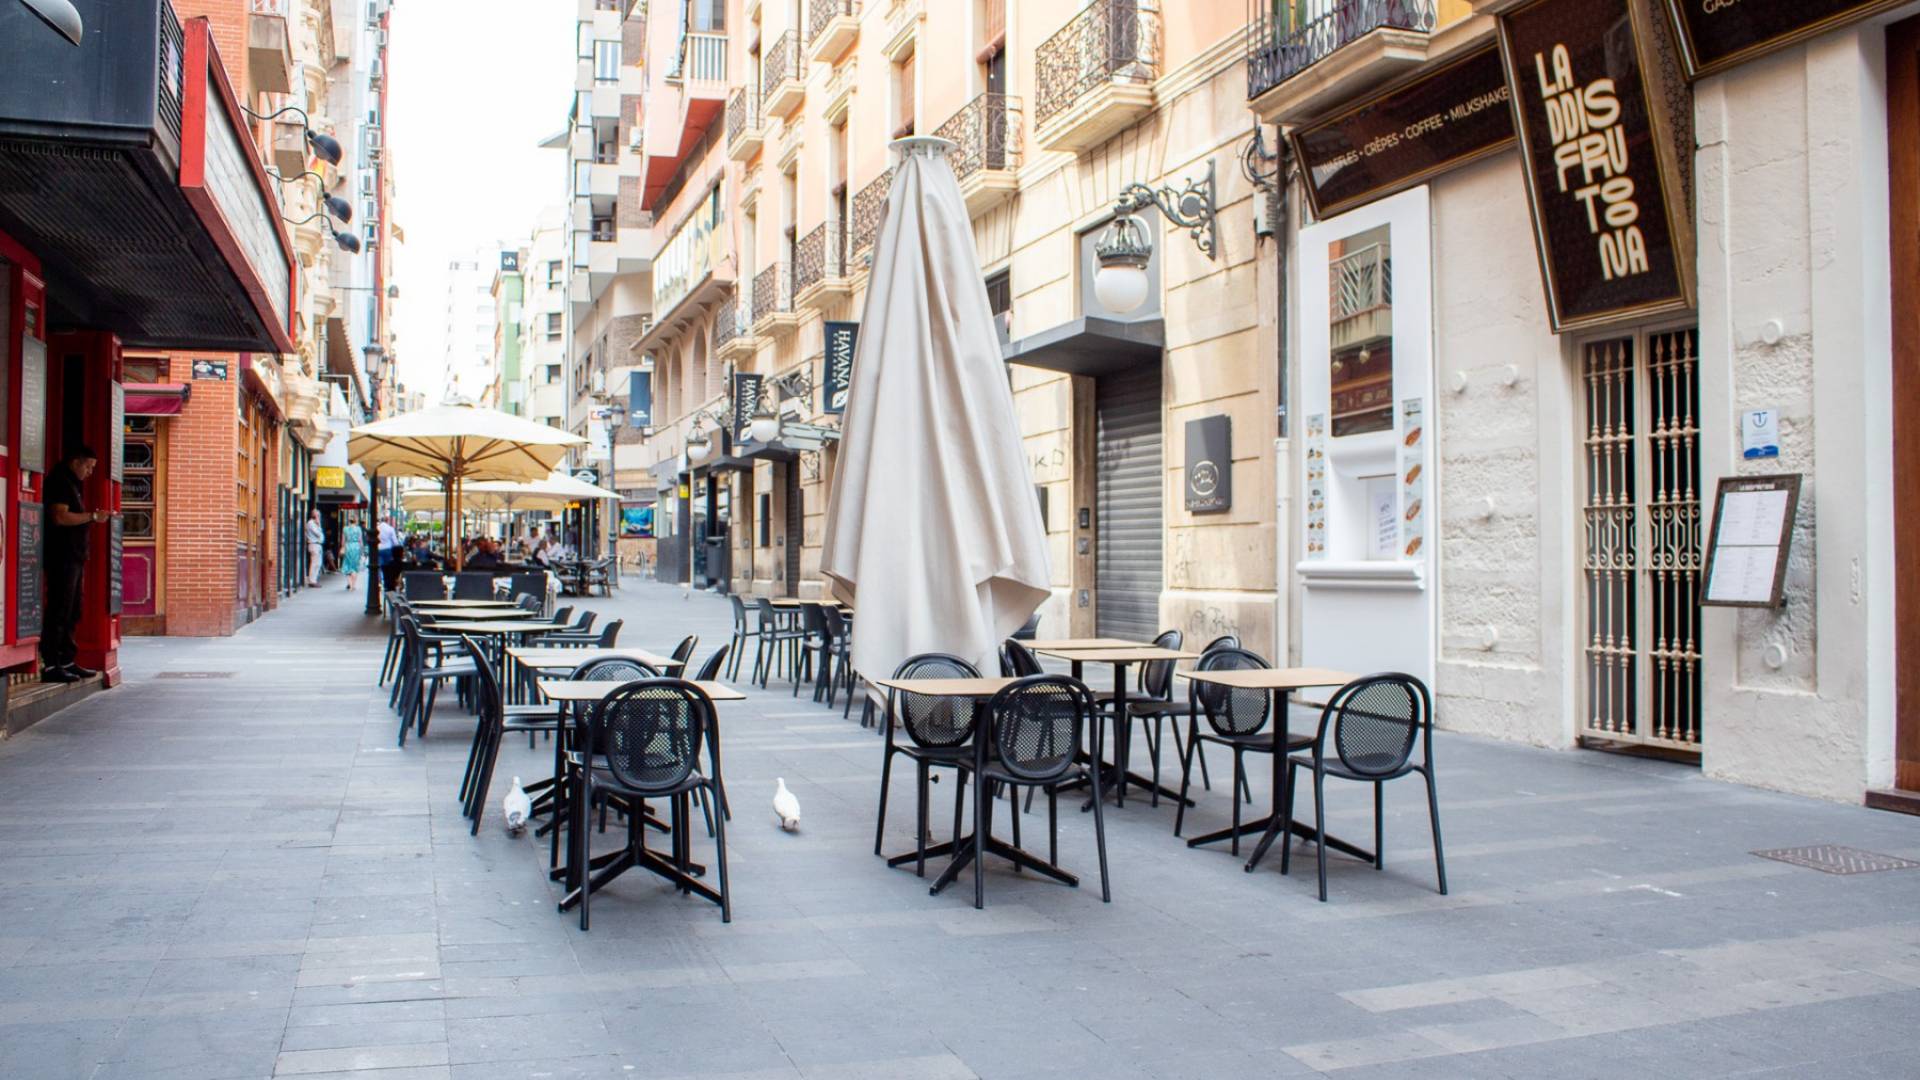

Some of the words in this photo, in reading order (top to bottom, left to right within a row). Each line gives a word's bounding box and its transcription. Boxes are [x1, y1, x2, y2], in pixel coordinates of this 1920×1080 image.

[1535, 43, 1574, 98] LA
[1320, 150, 1360, 175] WAFFLES
[1363, 132, 1400, 156] CRÊPES
[1405, 113, 1444, 140] COFFEE
[1599, 225, 1649, 281] NA
[837, 330, 851, 389] HAVANA
